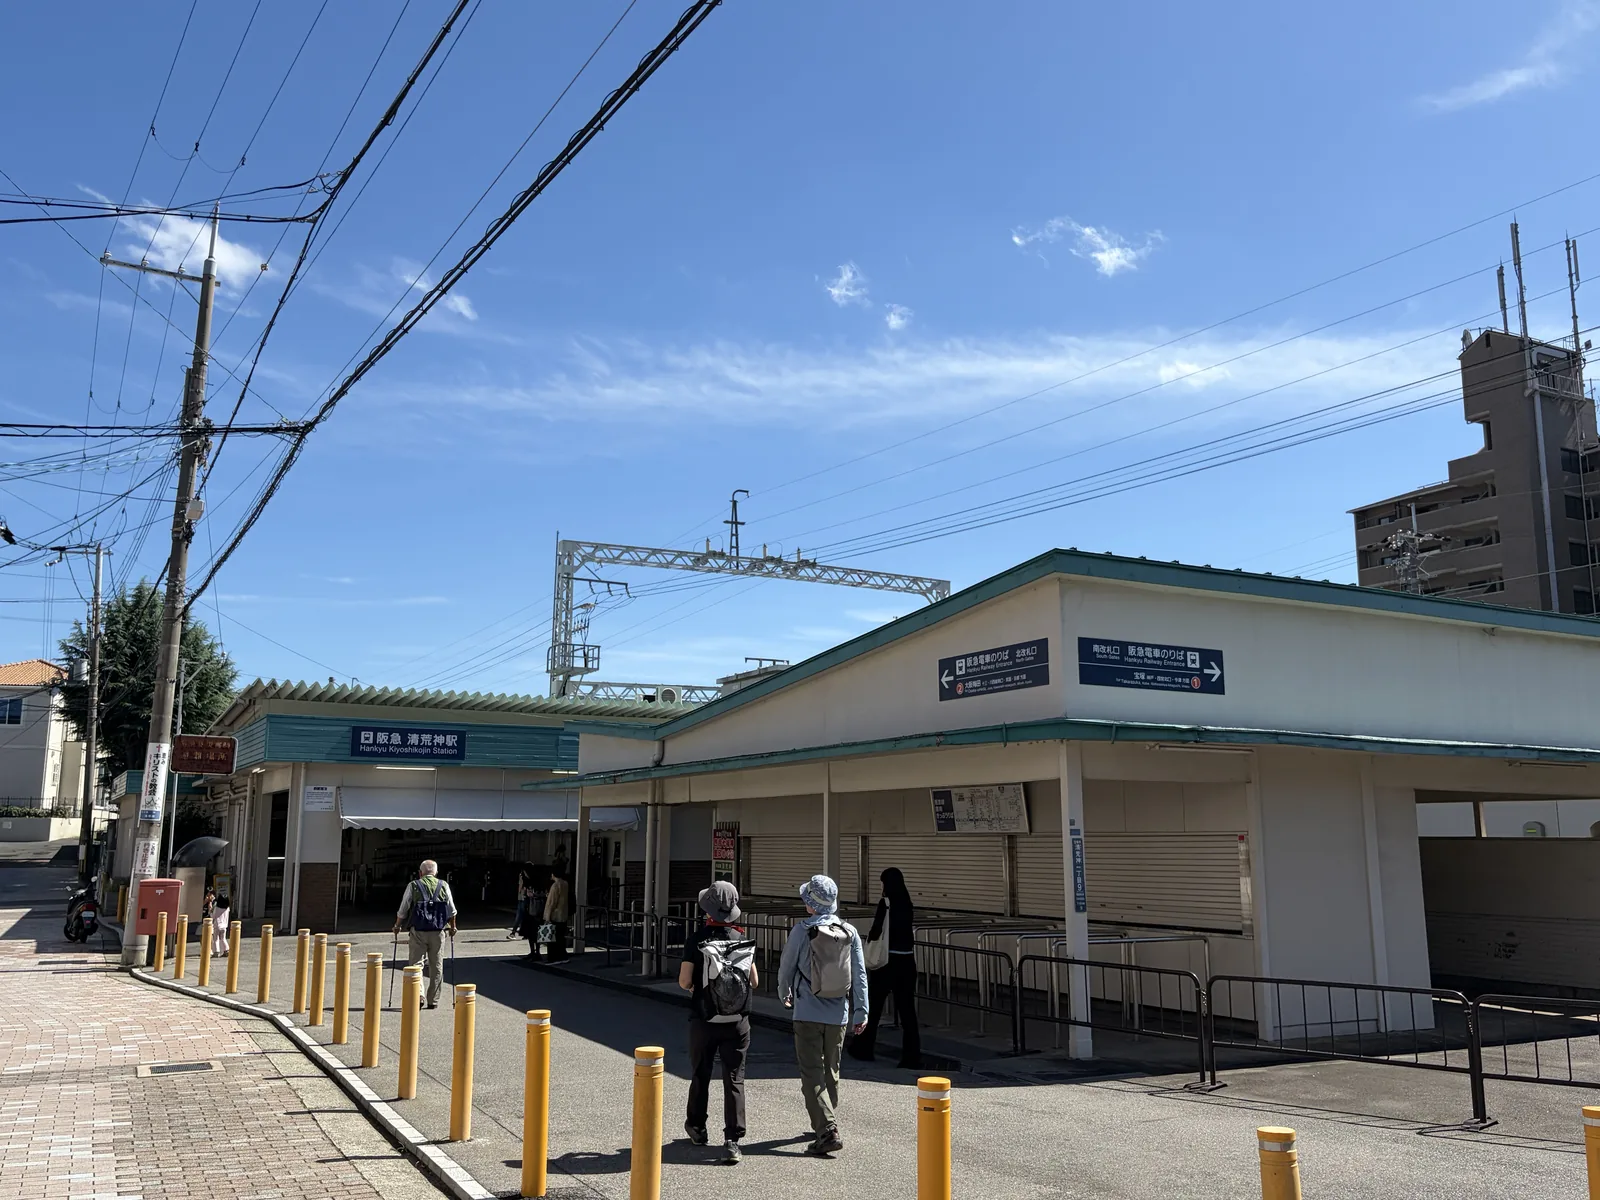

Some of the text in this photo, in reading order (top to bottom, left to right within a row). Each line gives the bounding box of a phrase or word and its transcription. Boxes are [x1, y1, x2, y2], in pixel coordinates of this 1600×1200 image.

[967, 646, 1037, 667] 阪急電車のりば 北改札口
[1093, 644, 1184, 660] 南改札口 阪急電車のりば
[1144, 658, 1162, 666] Railway
[1133, 672, 1145, 680] 宝塚
[376, 732, 458, 747] 阪急 清荒神駅
[360, 745, 458, 755] Hankyu Kiyoshikojin Station
[148, 753, 161, 796] キリストの教会
